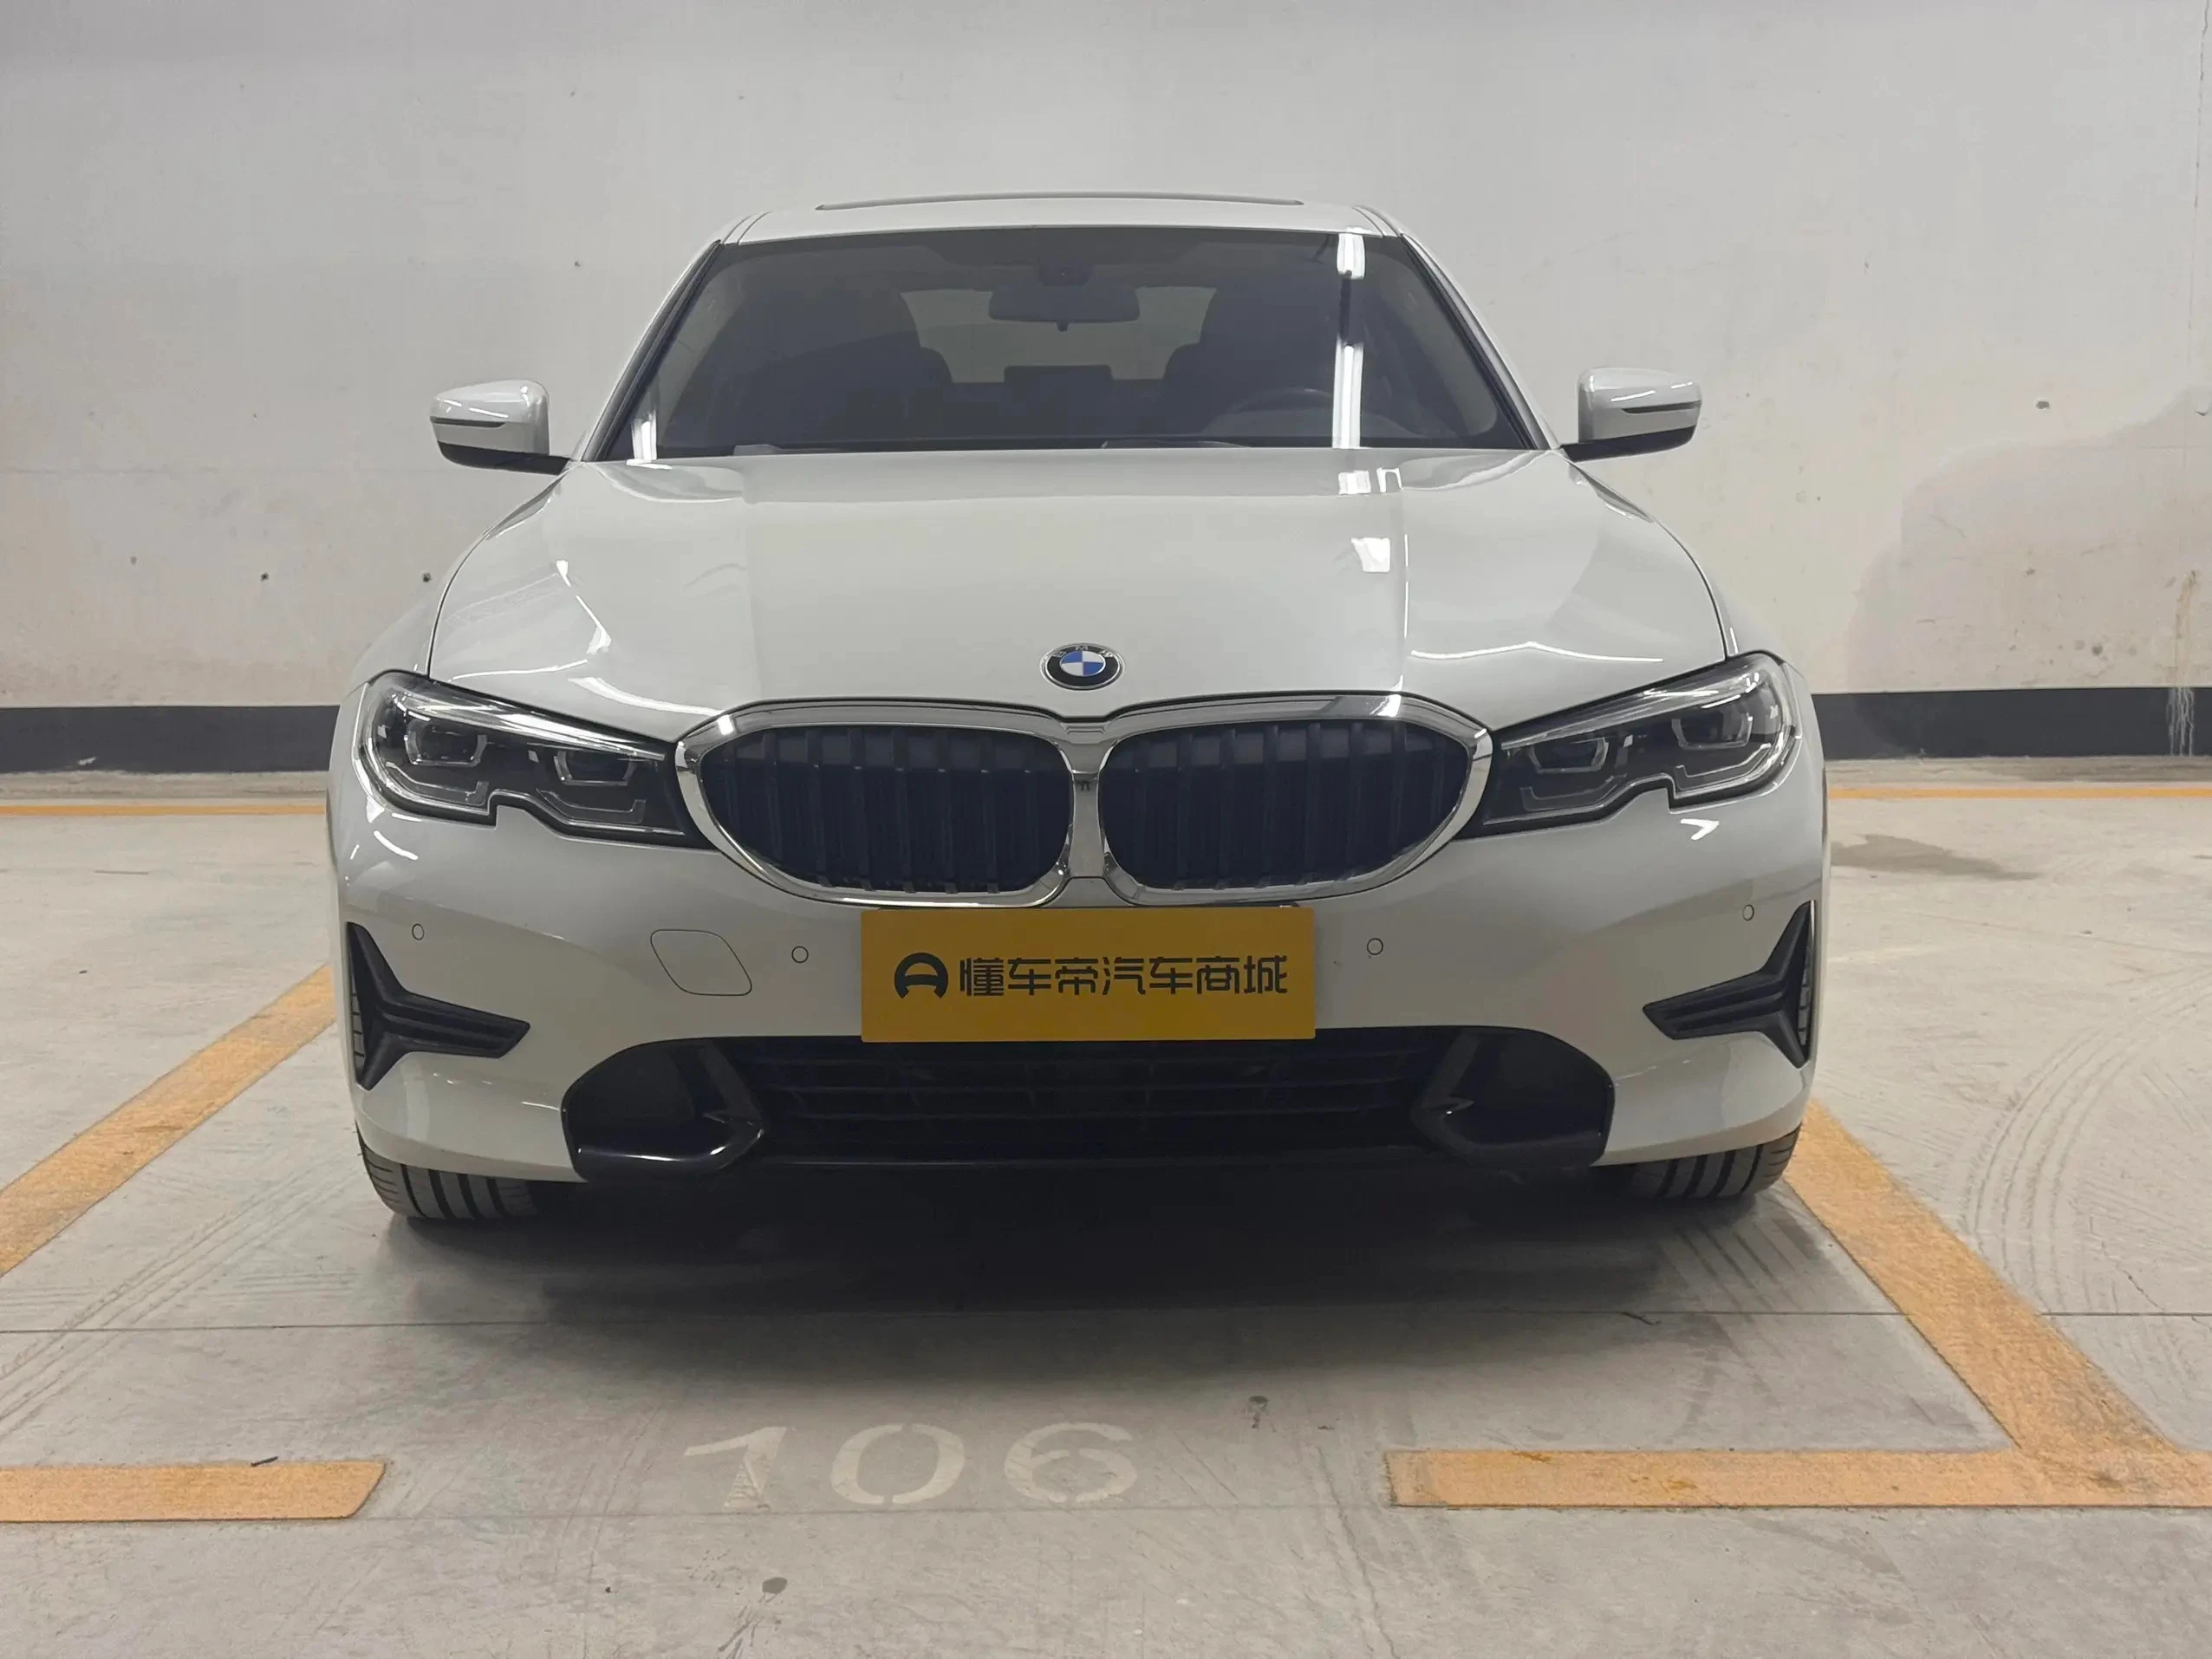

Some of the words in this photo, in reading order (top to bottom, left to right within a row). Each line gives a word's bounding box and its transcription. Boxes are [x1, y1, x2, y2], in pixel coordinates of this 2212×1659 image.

[960, 955, 1288, 997] 懂车帝汽车商城
[684, 1422, 1137, 1510] 106
